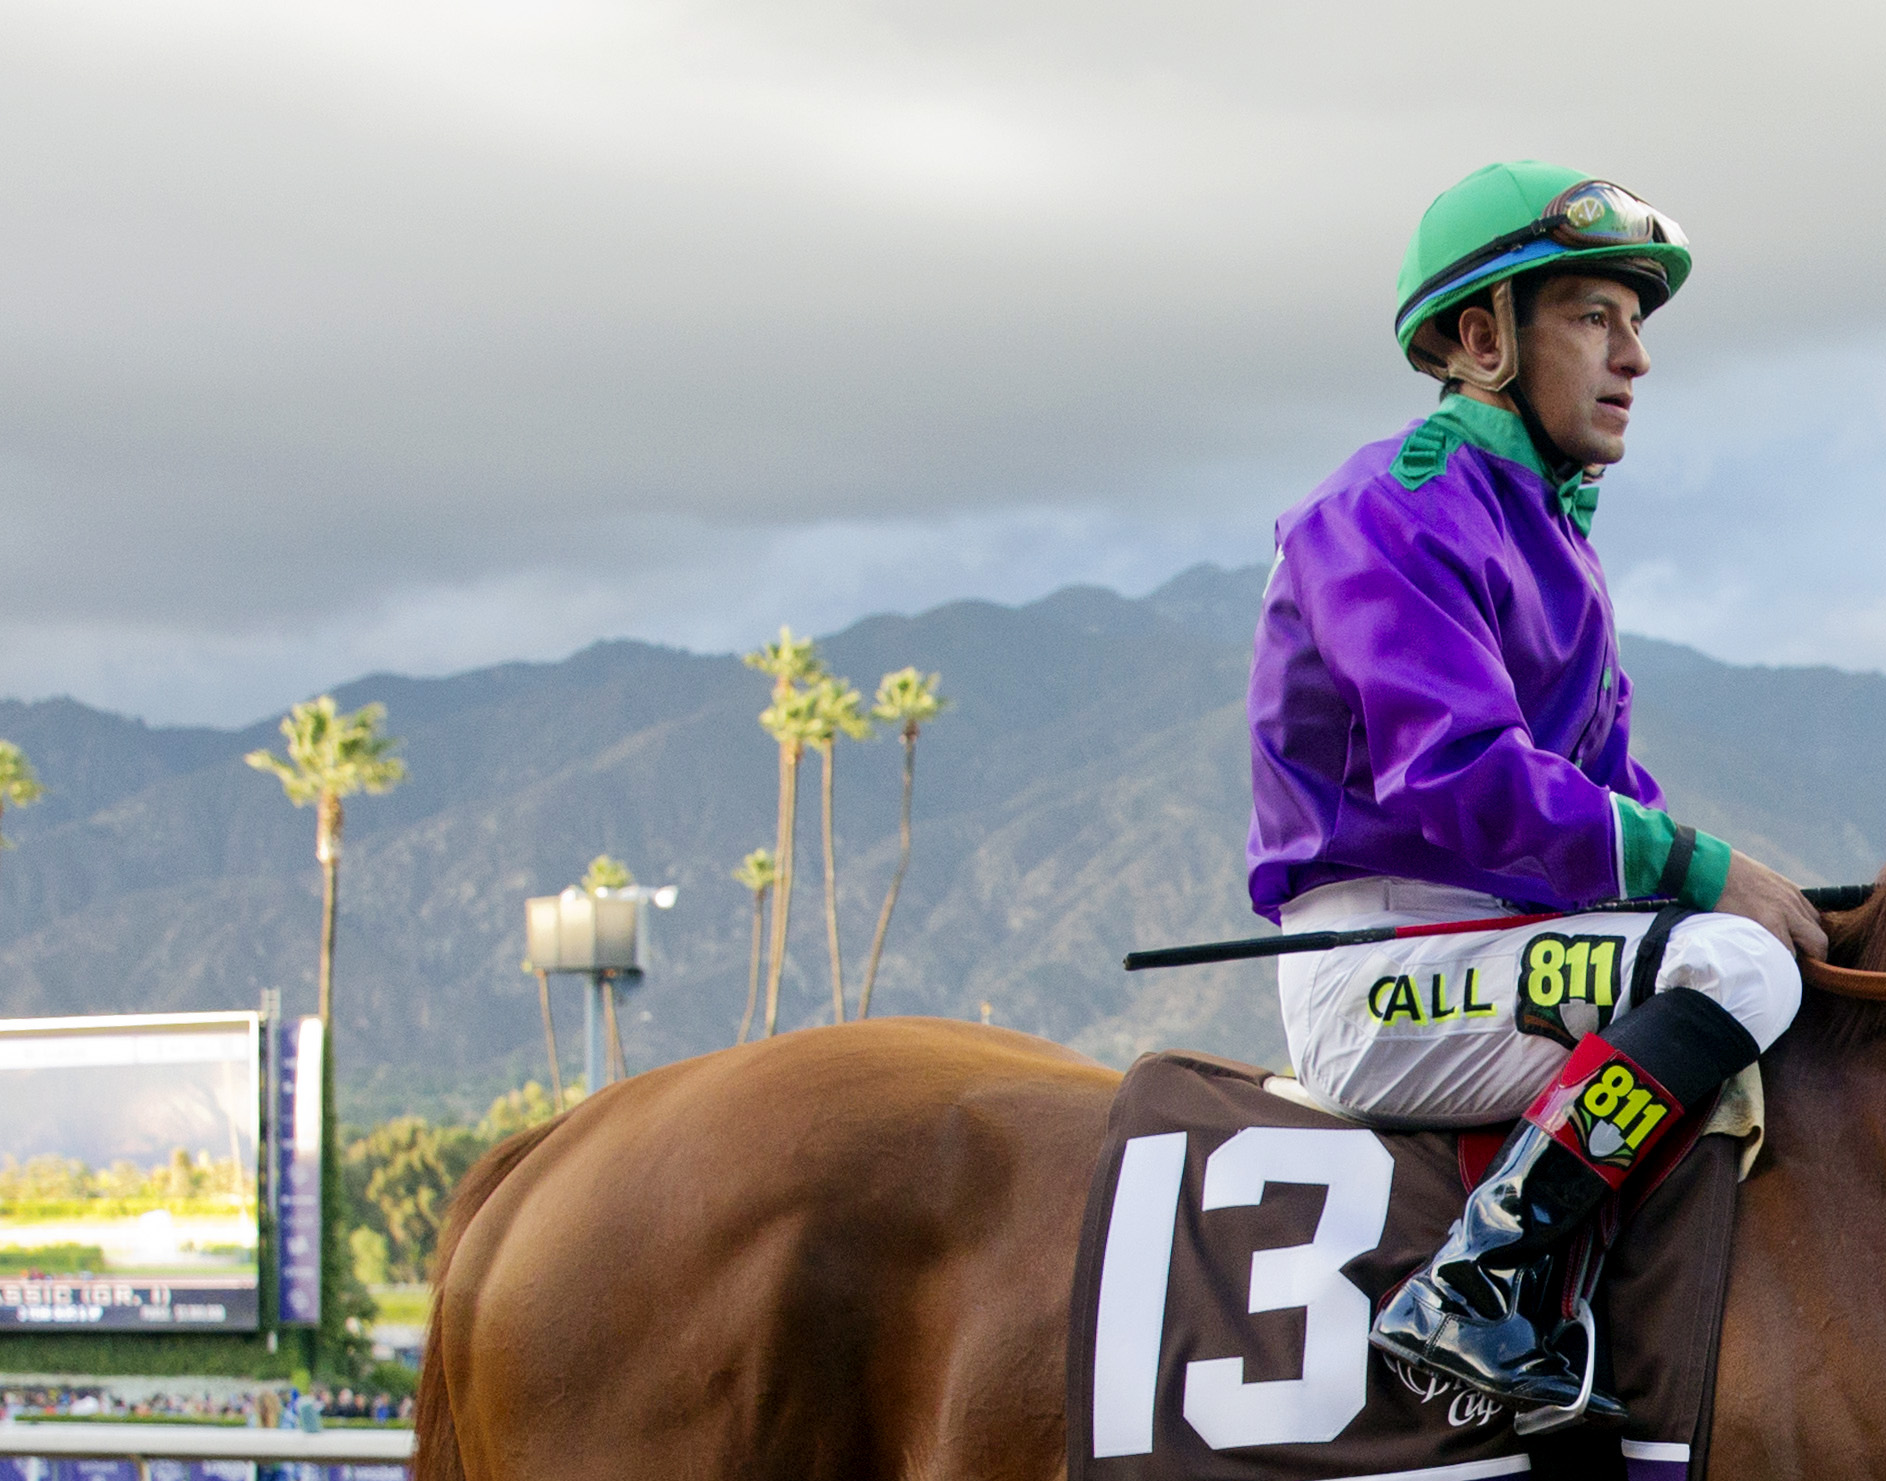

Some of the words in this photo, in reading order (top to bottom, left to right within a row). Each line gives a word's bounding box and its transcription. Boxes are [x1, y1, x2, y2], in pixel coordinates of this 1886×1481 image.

[1367, 967, 1498, 1027] CALL
[1527, 939, 1616, 1008] 811
[1583, 1064, 1668, 1150] 811
[0, 1284, 73, 1306] SSIC
[1092, 1126, 1396, 1459] 13
